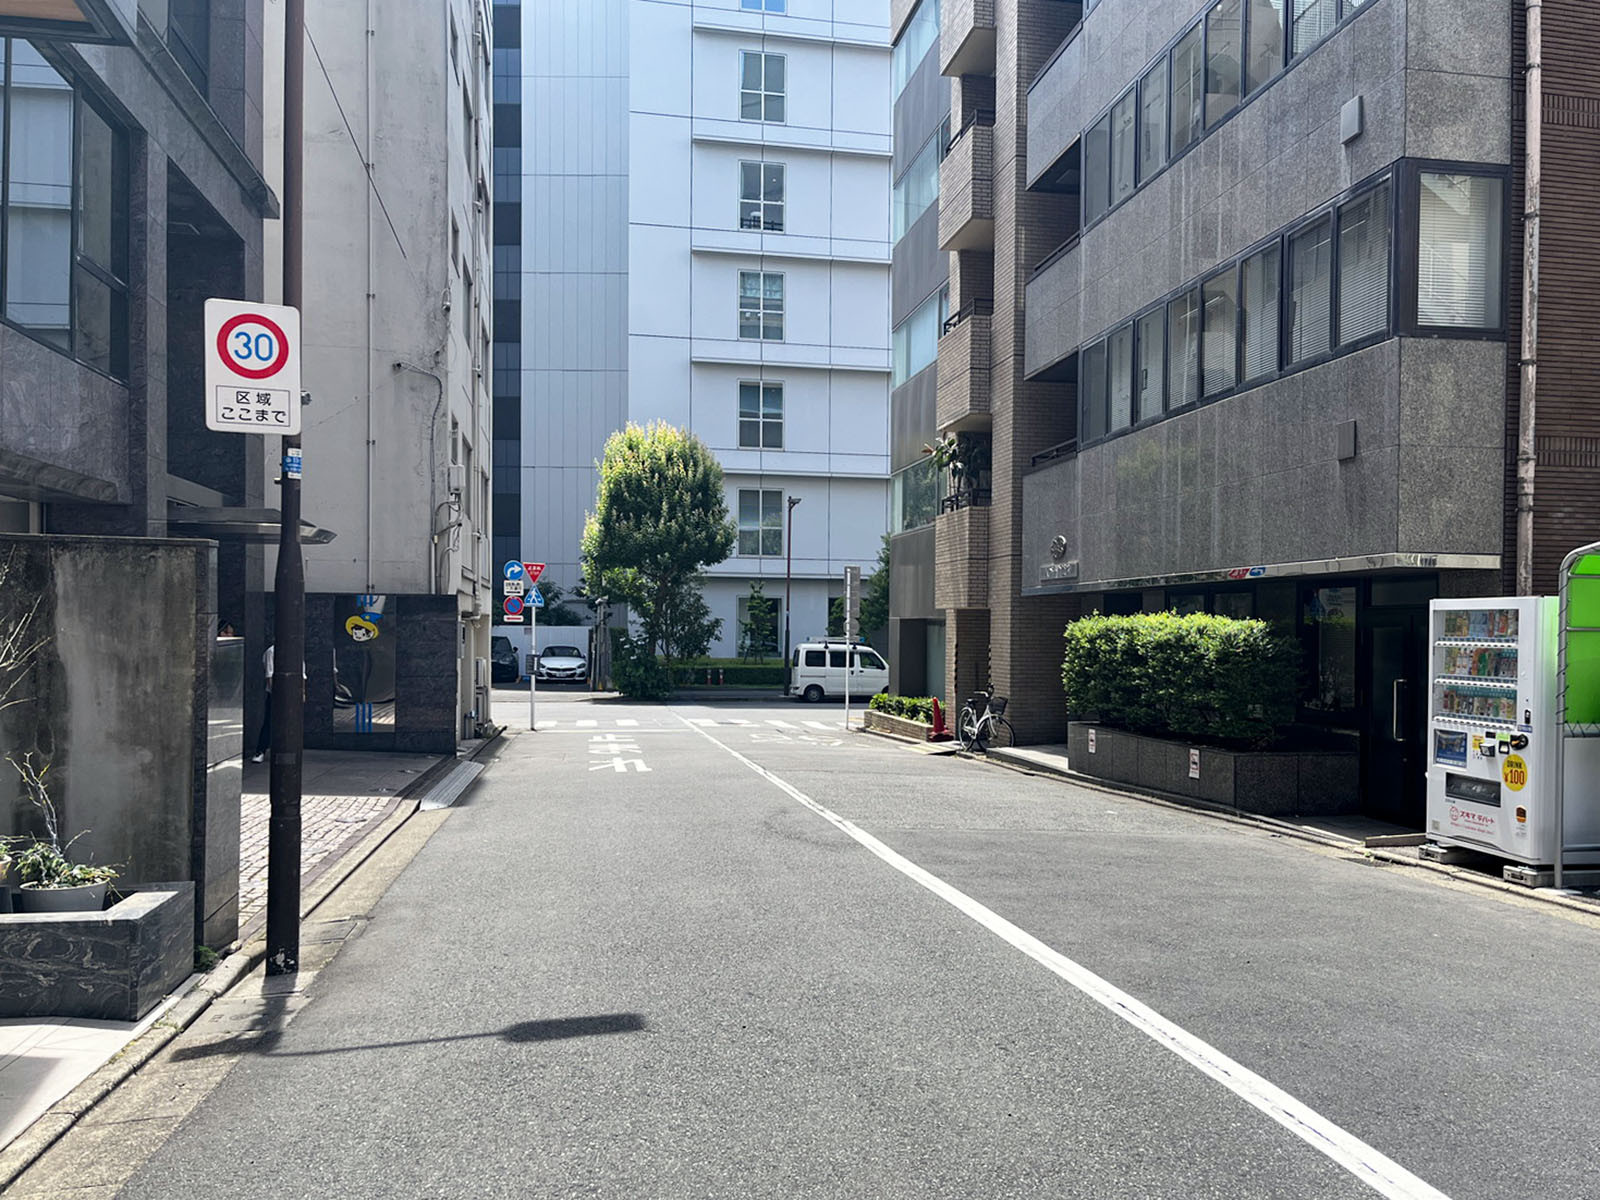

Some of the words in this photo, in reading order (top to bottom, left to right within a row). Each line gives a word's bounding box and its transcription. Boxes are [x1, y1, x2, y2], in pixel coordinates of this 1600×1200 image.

[234, 331, 273, 361] 30
[236, 391, 271, 406] 区域
[221, 406, 286, 424] ここまで
[588, 733, 652, 772] 止まれ
[1507, 759, 1522, 769] DRINK
